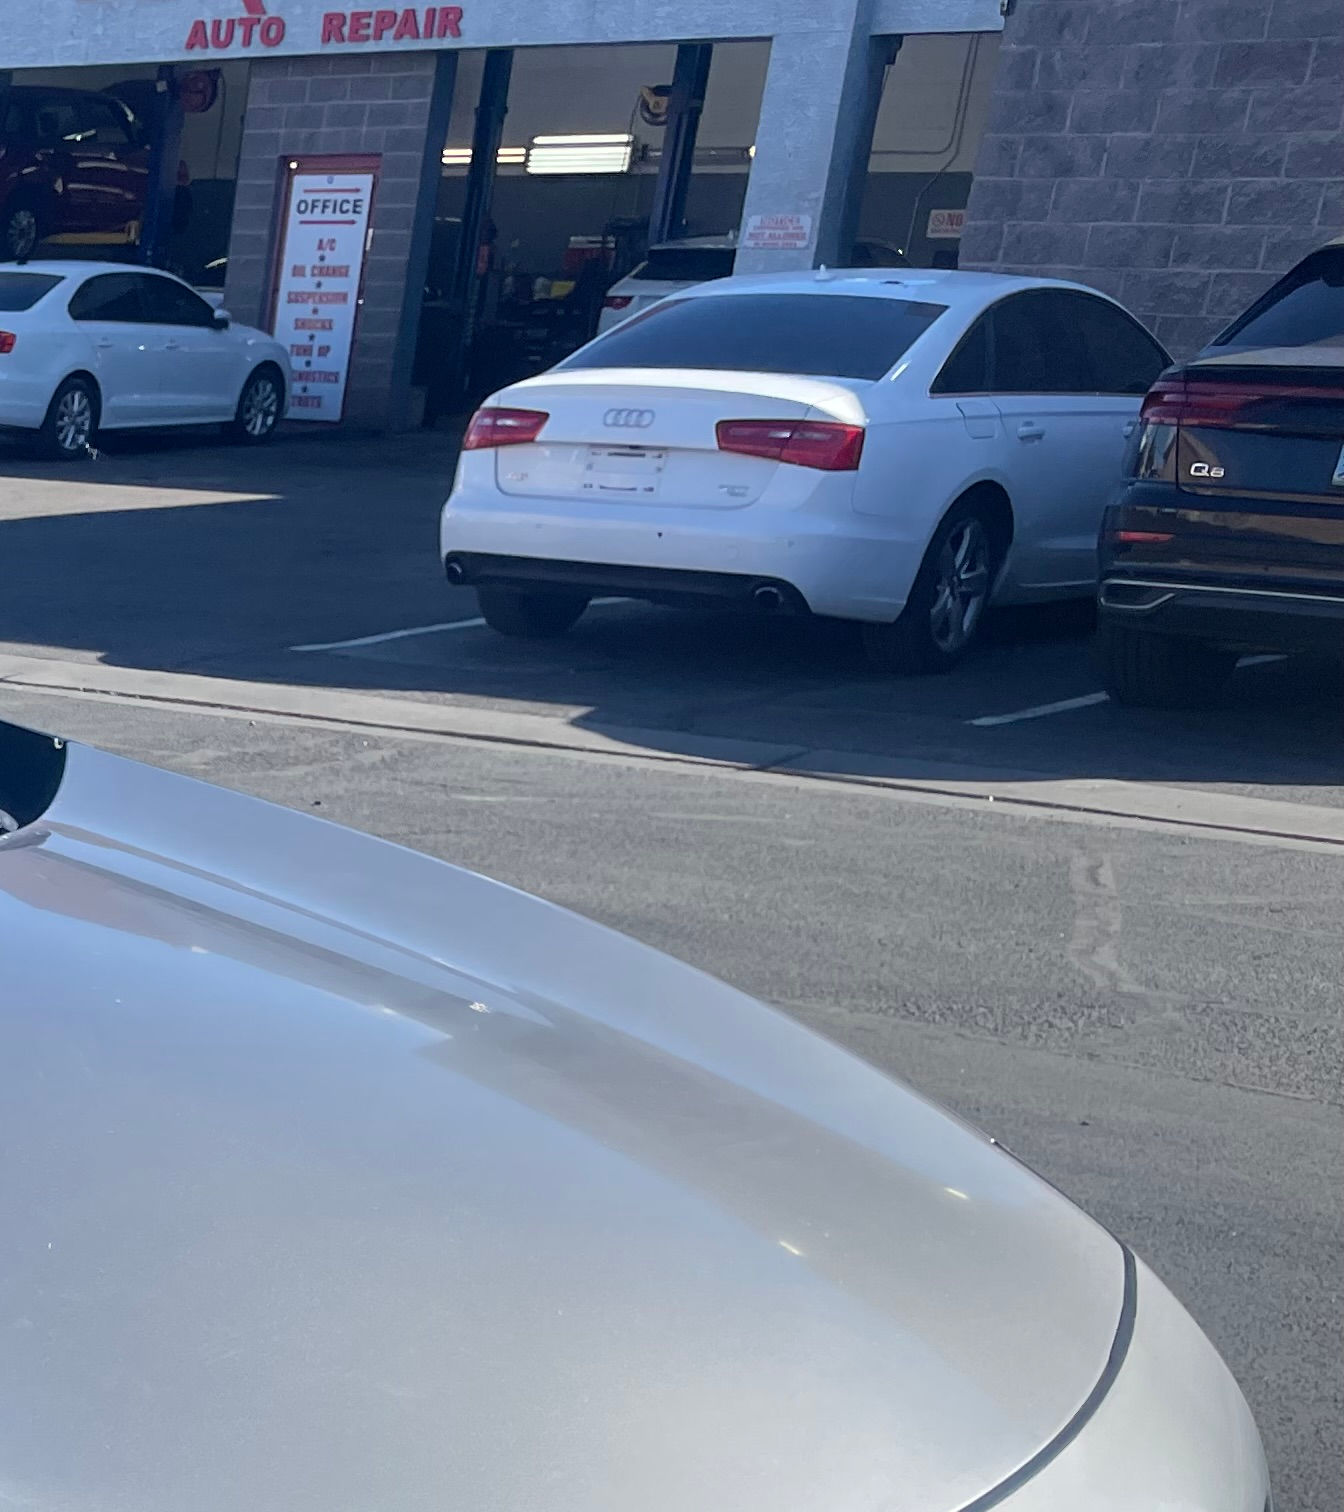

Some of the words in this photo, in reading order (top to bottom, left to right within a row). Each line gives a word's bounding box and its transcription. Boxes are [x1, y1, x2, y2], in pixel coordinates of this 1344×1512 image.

[185, 17, 286, 49] AUTO
[321, 6, 463, 43] REPAIR
[296, 198, 363, 215] OFFICE
